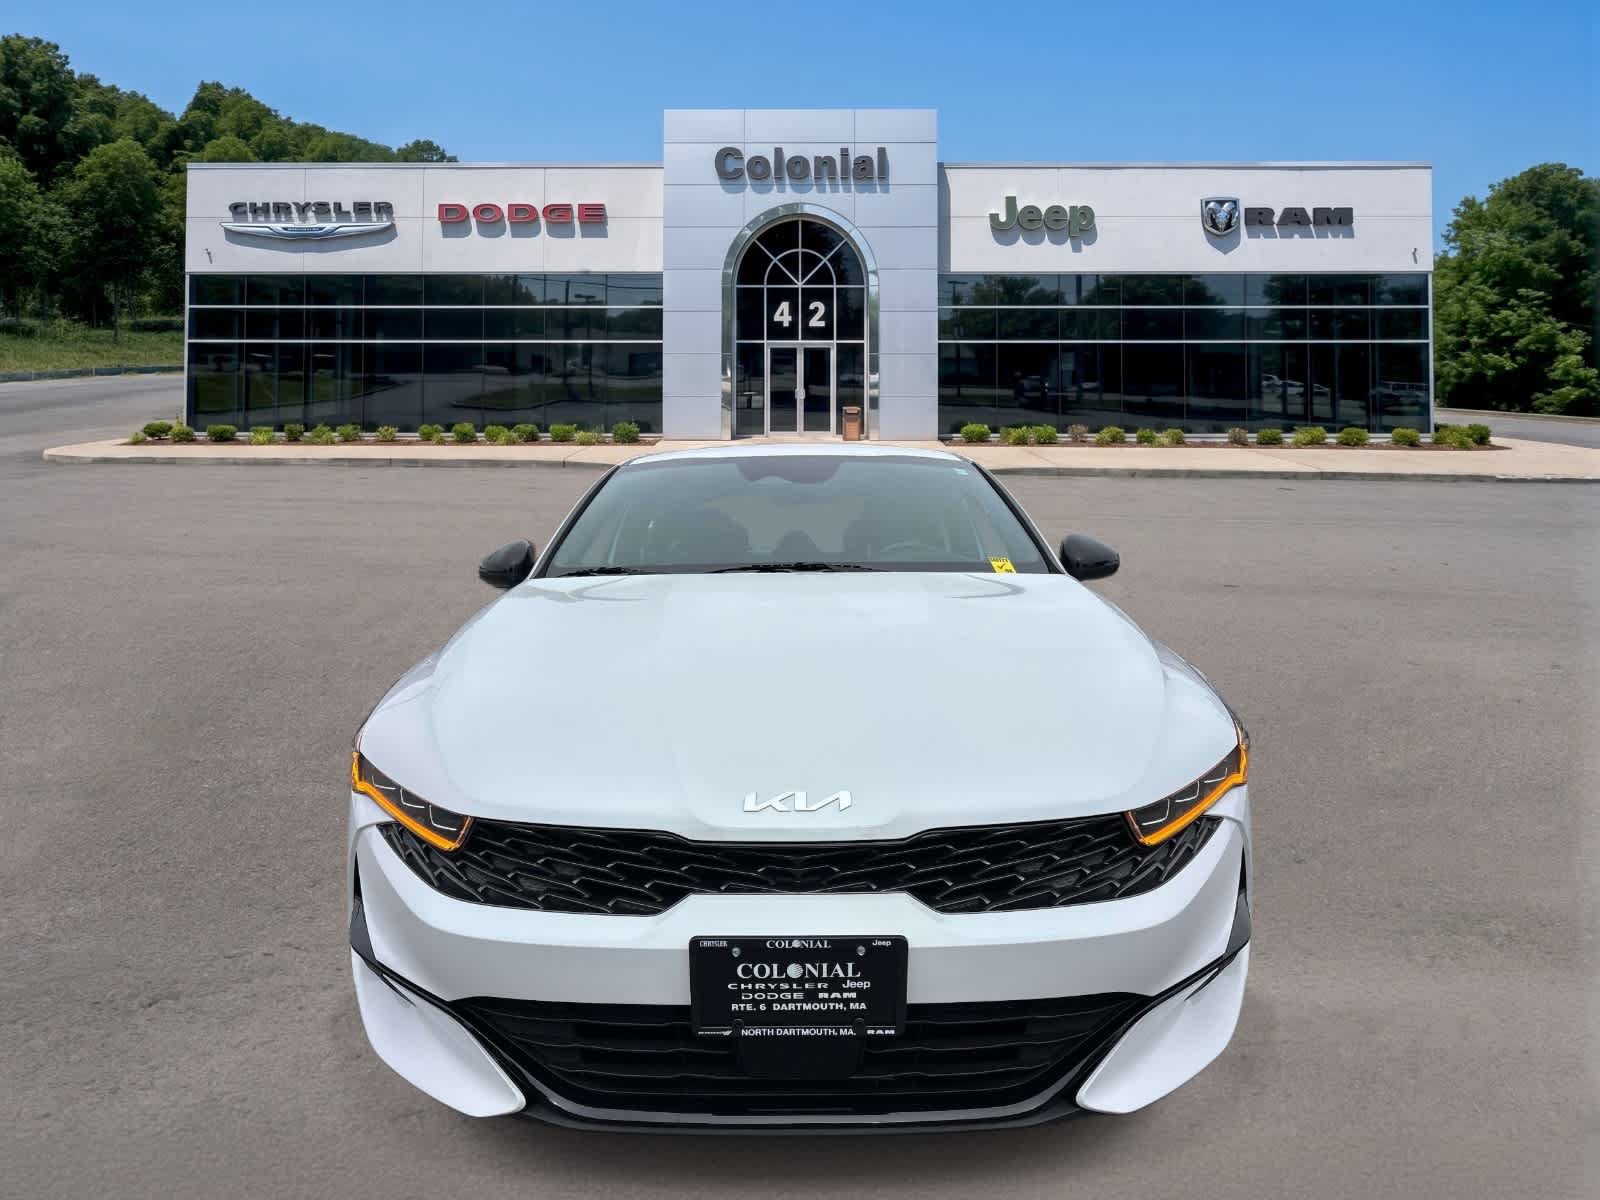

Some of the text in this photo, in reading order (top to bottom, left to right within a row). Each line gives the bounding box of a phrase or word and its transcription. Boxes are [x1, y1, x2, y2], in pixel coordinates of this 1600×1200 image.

[714, 146, 889, 180] Colonial
[228, 201, 394, 216] CHRYSLER
[438, 203, 607, 224] DODGE
[988, 195, 1095, 237] Jeep
[1244, 207, 1354, 226] RAM
[743, 791, 852, 813] KIA
[842, 980, 871, 990] Jeep
[741, 992, 805, 1000] DODGE
[731, 1002, 867, 1012] RTE. 6 DARTMOUTH, MA
[741, 1029, 774, 1037] NORTH
